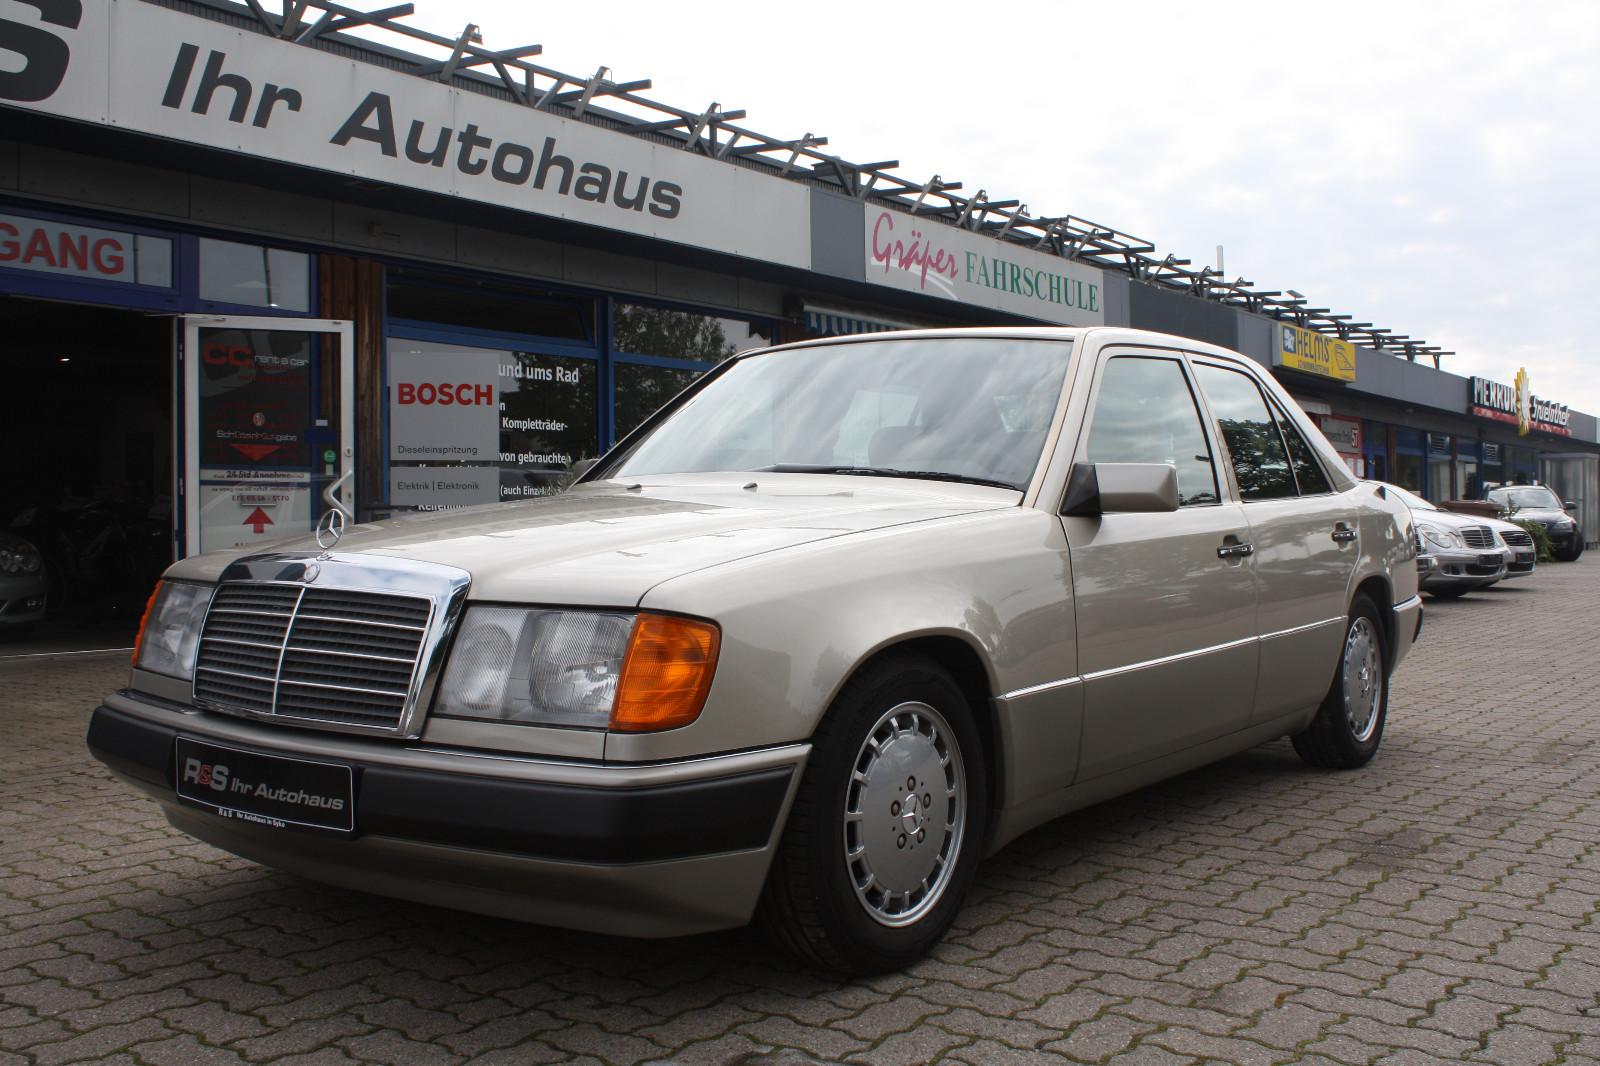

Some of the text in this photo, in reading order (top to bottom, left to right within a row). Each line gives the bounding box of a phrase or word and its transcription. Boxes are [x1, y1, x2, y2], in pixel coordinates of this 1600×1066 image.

[162, 43, 302, 128] Ihr
[330, 92, 683, 219] Autohaus
[965, 250, 1099, 313] FAHRSCHULE
[1297, 329, 1329, 363] HELMS
[527, 366, 552, 381] ums
[556, 367, 579, 383] Rad
[397, 383, 493, 405] BOSCH
[502, 416, 568, 432] Kompletträder-
[397, 445, 478, 456] Dieseleinspritzung
[397, 481, 429, 490] Elektrik
[437, 481, 480, 491] Elektronik
[500, 484, 521, 497] (auch
[183, 757, 344, 811] R&S Ihr Autohaus
